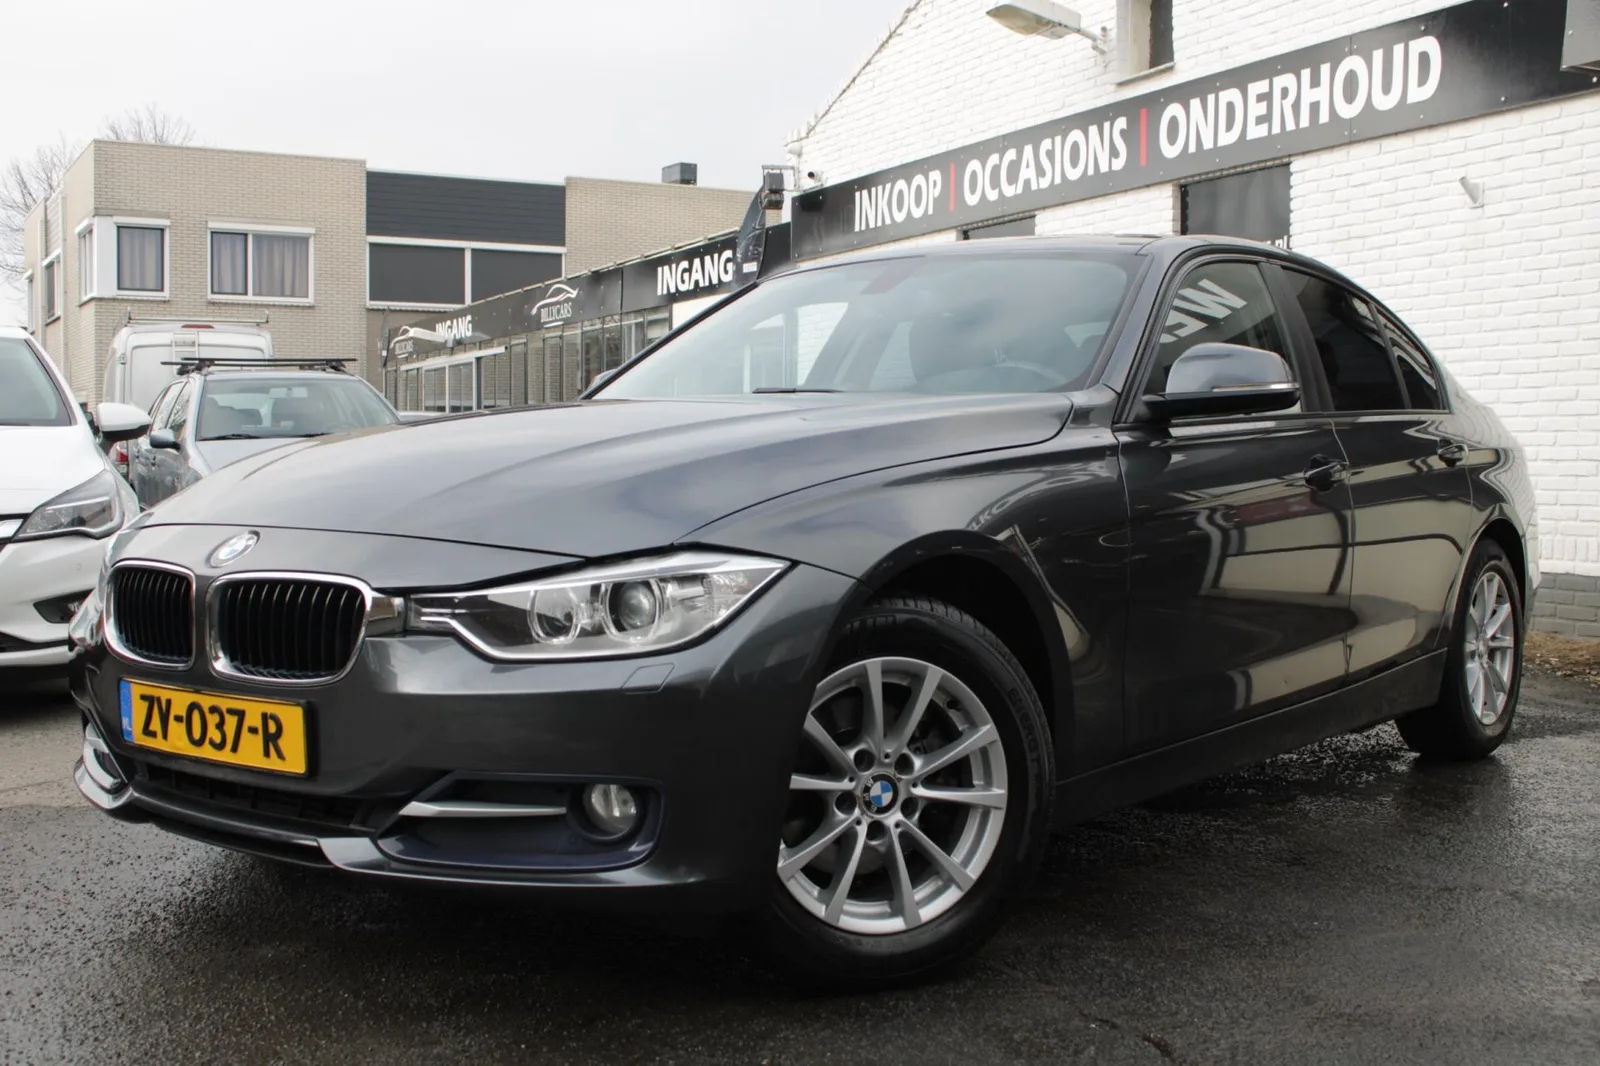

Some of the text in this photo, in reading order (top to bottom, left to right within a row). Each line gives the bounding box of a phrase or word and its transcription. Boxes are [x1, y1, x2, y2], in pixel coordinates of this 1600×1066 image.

[854, 35, 1442, 232] INKOOP OCCASIONS ONDERHOUD
[657, 250, 733, 296] INGANG
